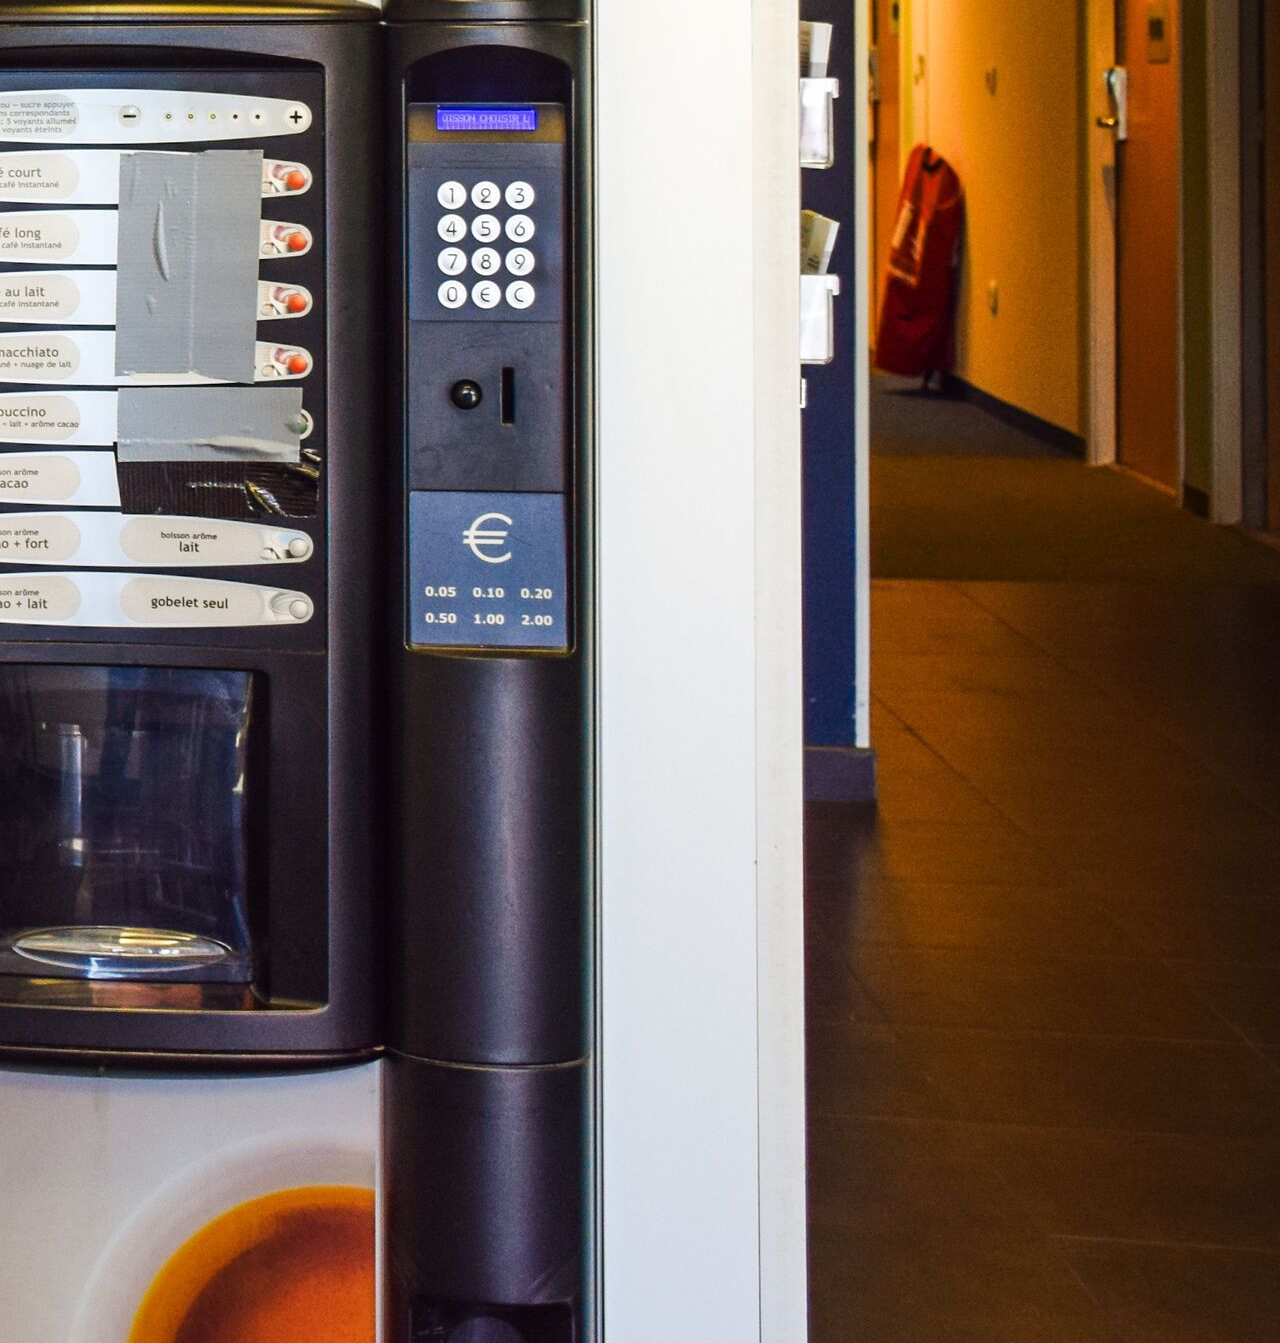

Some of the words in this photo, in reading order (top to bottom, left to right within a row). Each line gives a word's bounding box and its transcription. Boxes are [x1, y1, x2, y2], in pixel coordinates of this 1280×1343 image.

[8, 167, 42, 179] court
[480, 187, 492, 203] 2
[514, 187, 525, 203] 3
[15, 227, 42, 242] long
[445, 220, 457, 236] 4
[480, 220, 491, 236] 5
[514, 220, 526, 236] 6
[447, 253, 458, 269] 7
[480, 253, 491, 269] 8
[514, 253, 526, 269] 9
[5, 288, 21, 298] au
[25, 286, 46, 298] lait
[160, 531, 190, 540] boisson
[192, 532, 218, 540] arôme
[462, 512, 513, 564] €
[25, 538, 49, 549] fort
[179, 541, 200, 553] lait
[425, 586, 457, 598] 0.05
[472, 587, 505, 598] 0.10
[520, 588, 552, 599] 0.20
[27, 598, 48, 609] lait
[151, 596, 199, 610] gobelet
[202, 597, 229, 609] seul
[425, 612, 457, 624] 0.50
[474, 613, 505, 625] 1.00
[521, 614, 553, 626] 2.00
